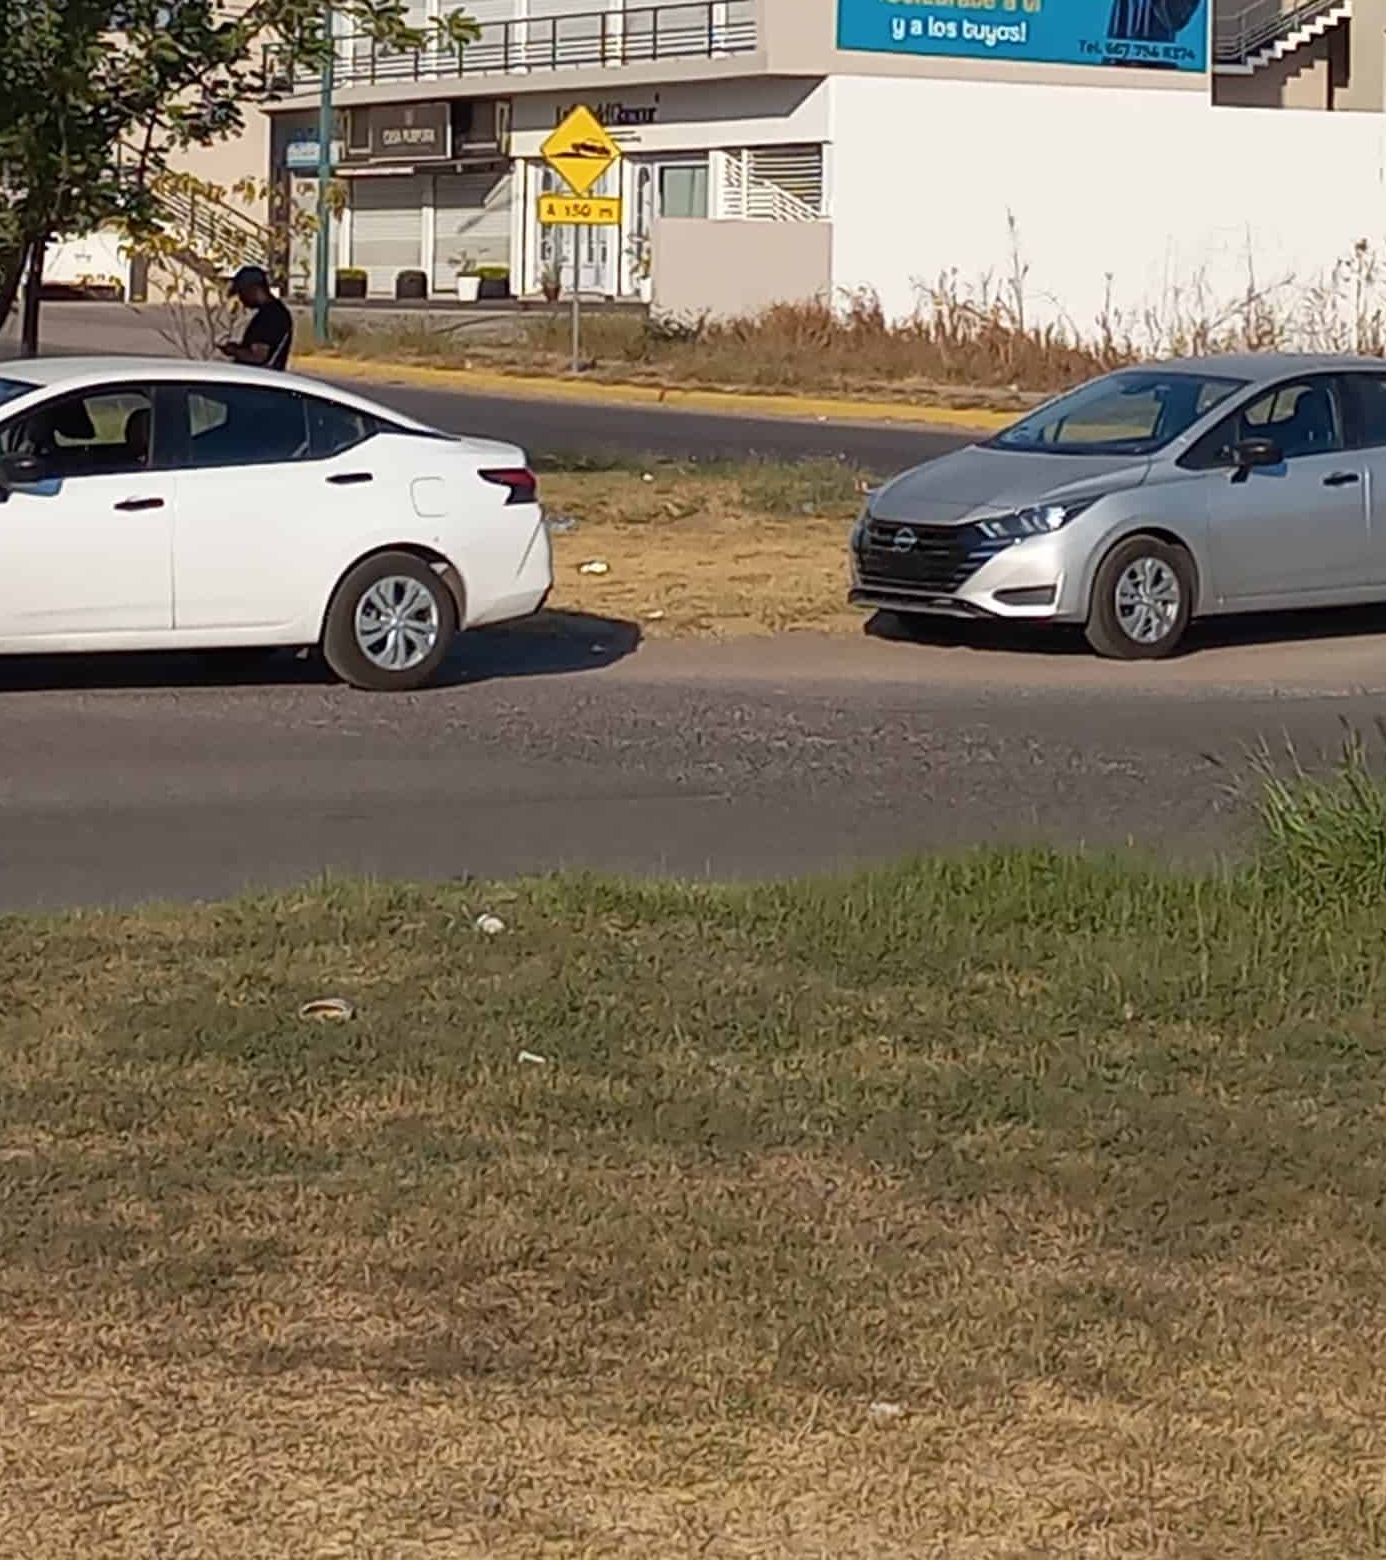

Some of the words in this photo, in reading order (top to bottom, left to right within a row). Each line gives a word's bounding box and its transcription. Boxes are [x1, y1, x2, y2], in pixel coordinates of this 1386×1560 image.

[891, 16, 906, 41] y
[909, 18, 923, 36] a
[927, 15, 957, 38] los
[547, 203, 556, 216] A
[564, 203, 592, 218] 150
[599, 208, 613, 218] m
